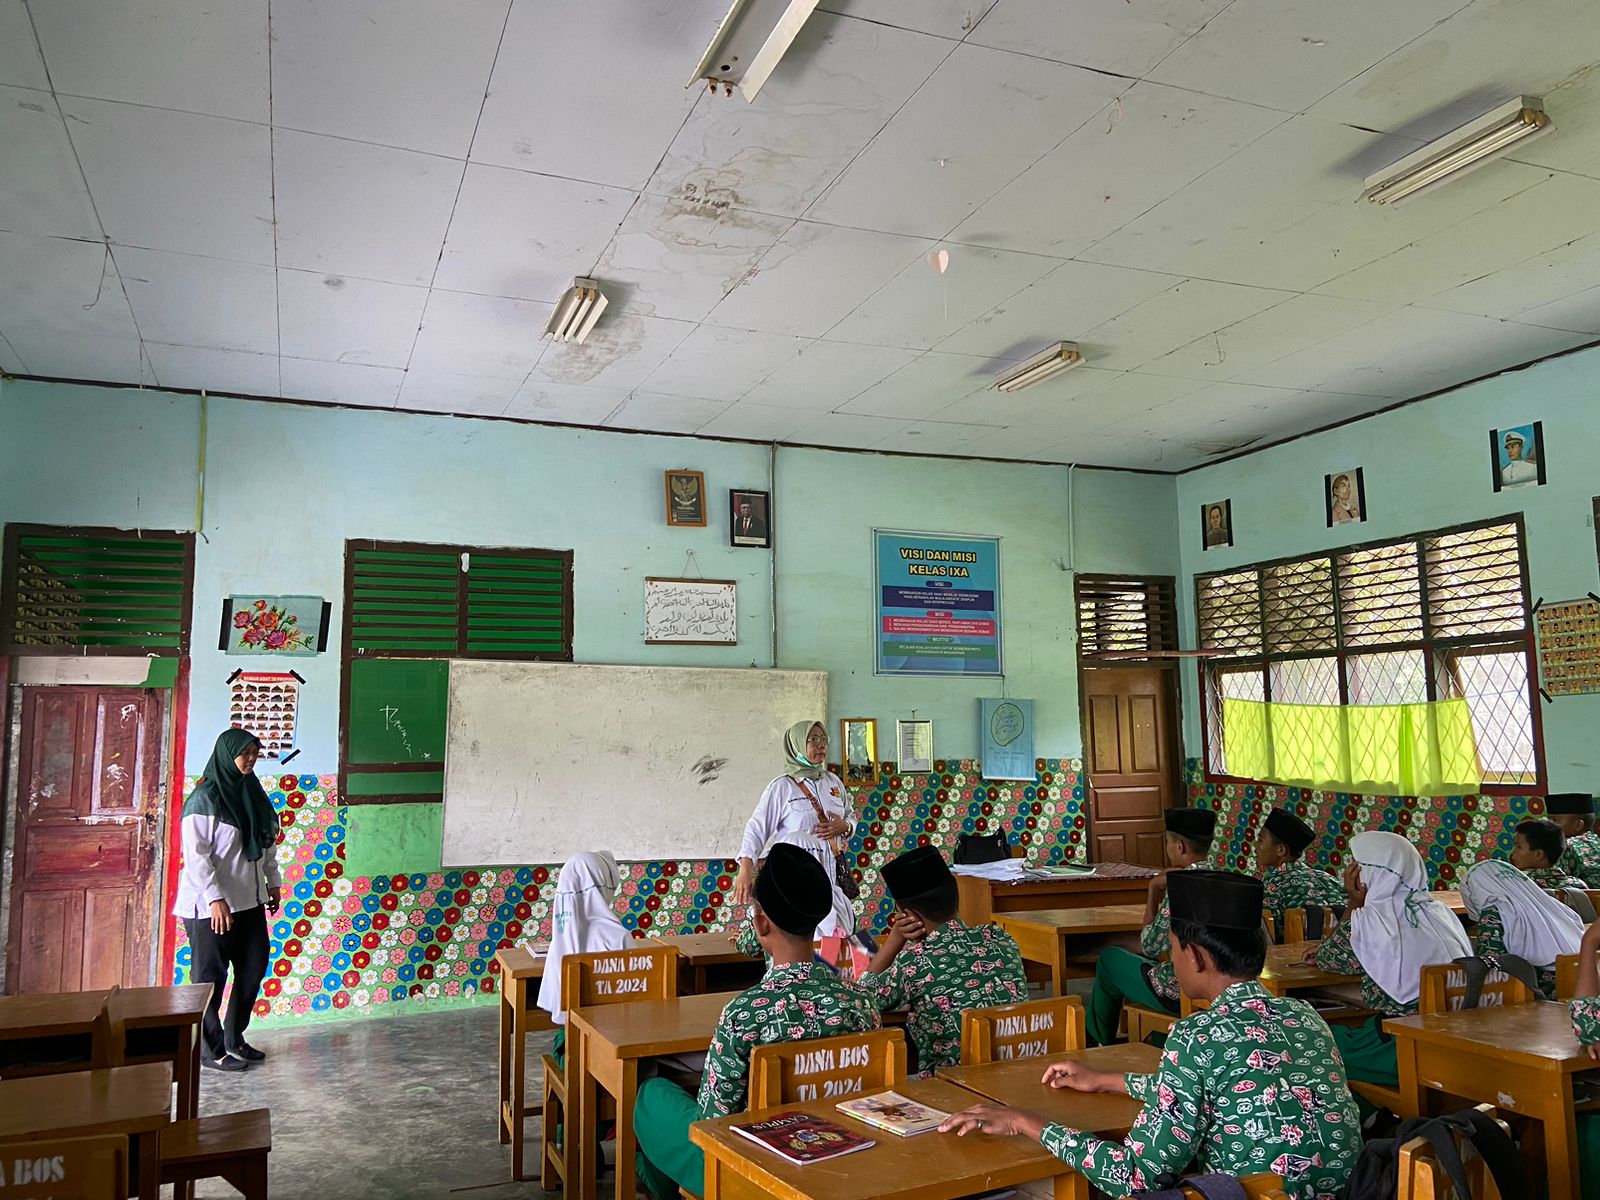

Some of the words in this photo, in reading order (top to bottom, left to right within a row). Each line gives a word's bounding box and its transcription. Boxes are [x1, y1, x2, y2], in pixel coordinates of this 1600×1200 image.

[900, 548, 923, 559] VISI
[926, 551, 949, 561] DAN
[952, 552, 976, 562] MISI
[909, 565, 946, 576] KELAS
[949, 567, 969, 577] IXA
[593, 958, 625, 974] DANA
[629, 955, 653, 971] BOS
[596, 980, 612, 995] TA
[615, 977, 648, 994] 2024
[995, 1015, 1027, 1038] DANA
[1030, 1012, 1054, 1032] BOS
[794, 1048, 835, 1075] DANA
[839, 1044, 869, 1069] BOS
[997, 1045, 1013, 1060] TA
[1017, 1039, 1048, 1058] 2024
[797, 1084, 817, 1103] TA
[823, 1076, 862, 1098] 2024
[14, 1155, 64, 1185] BOS
